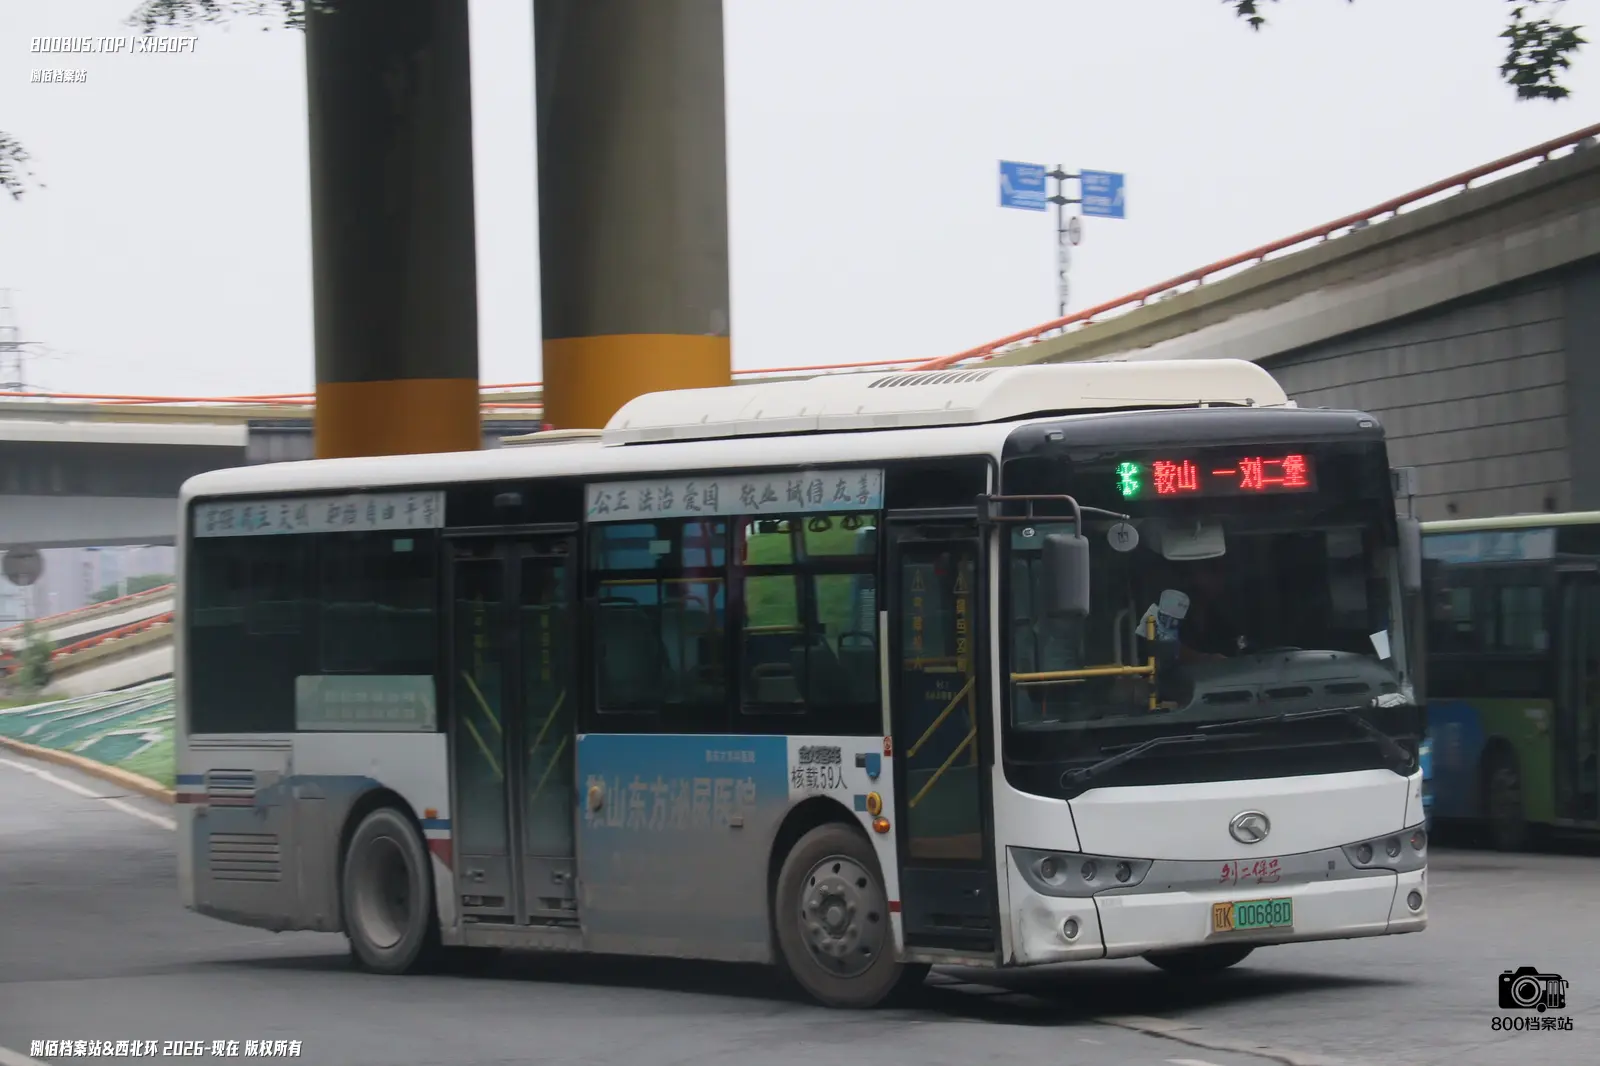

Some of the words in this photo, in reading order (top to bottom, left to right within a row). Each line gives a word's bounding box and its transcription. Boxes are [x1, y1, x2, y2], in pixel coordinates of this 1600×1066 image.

[1152, 460, 1198, 494] 鞍山
[791, 766, 848, 789] 核载59人
[1239, 904, 1291, 926] 00688D
